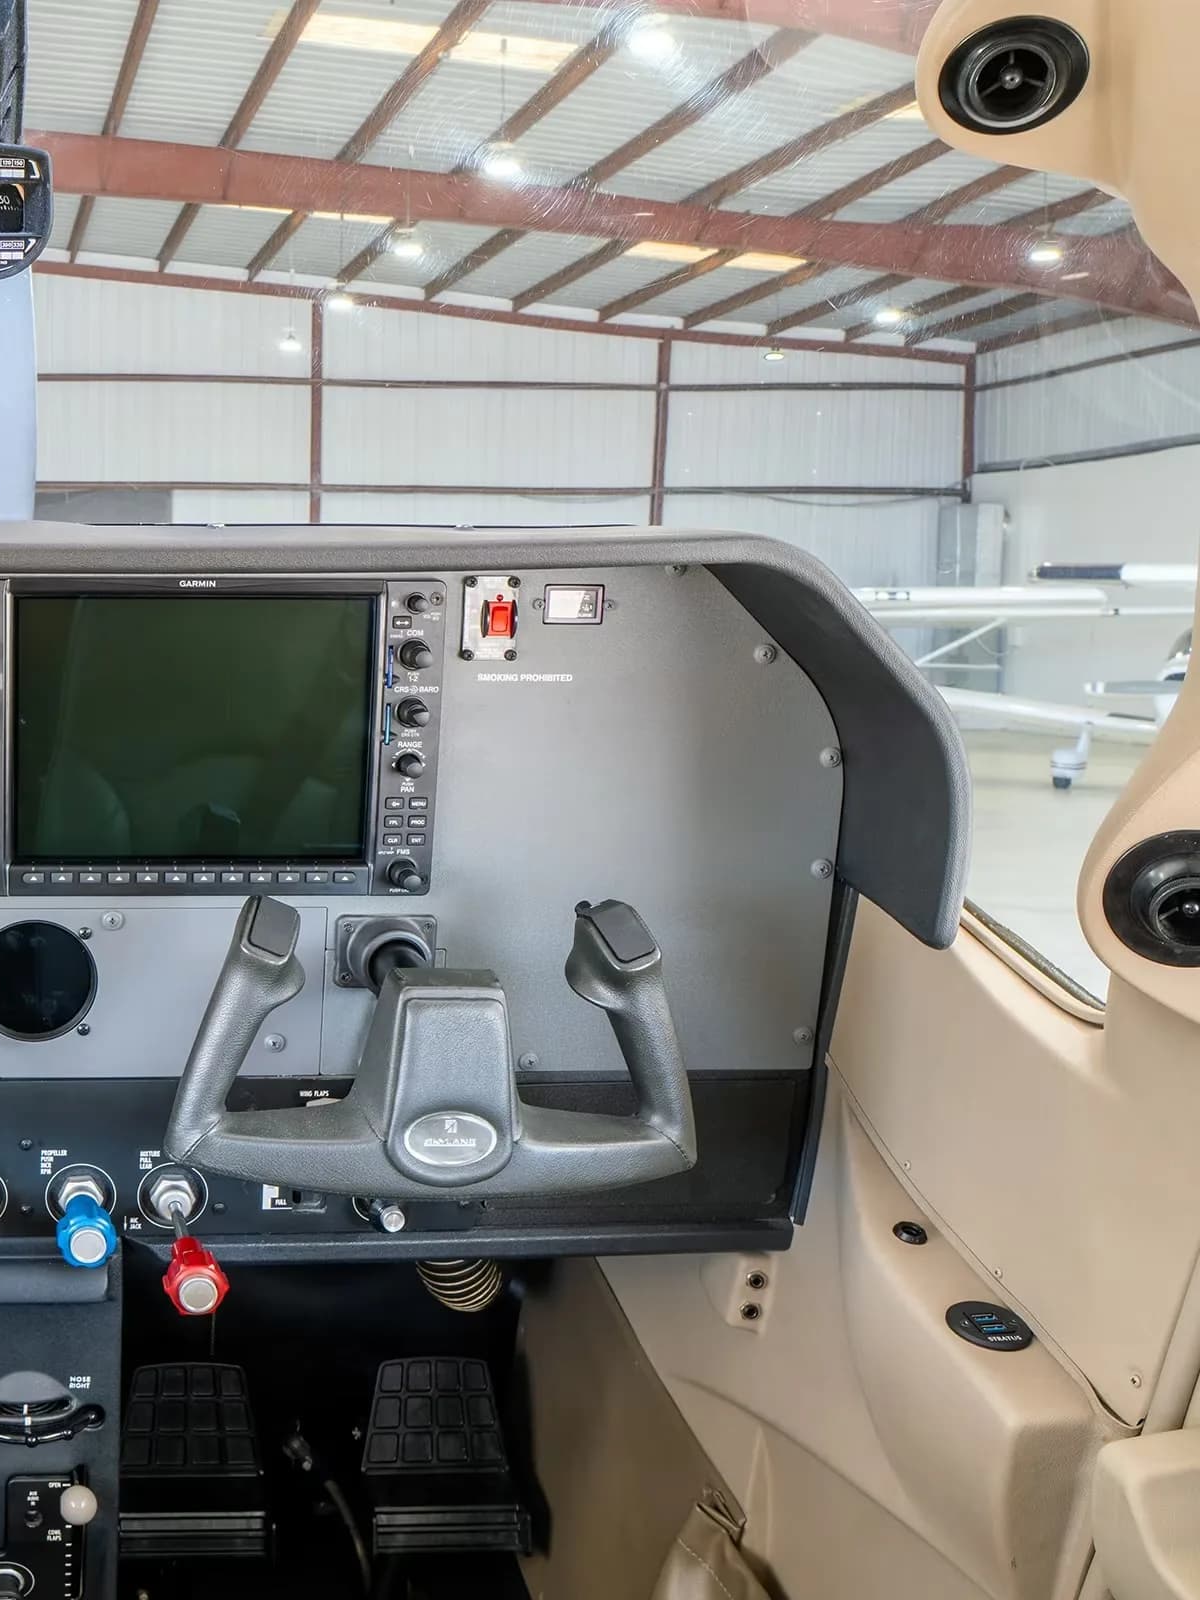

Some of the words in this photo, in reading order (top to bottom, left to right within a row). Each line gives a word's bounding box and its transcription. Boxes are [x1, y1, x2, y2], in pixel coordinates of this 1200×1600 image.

[179, 580, 216, 588] GARMIN
[406, 629, 424, 637] COM
[477, 674, 518, 682] SMOKING
[520, 674, 573, 682] PROHIBITED
